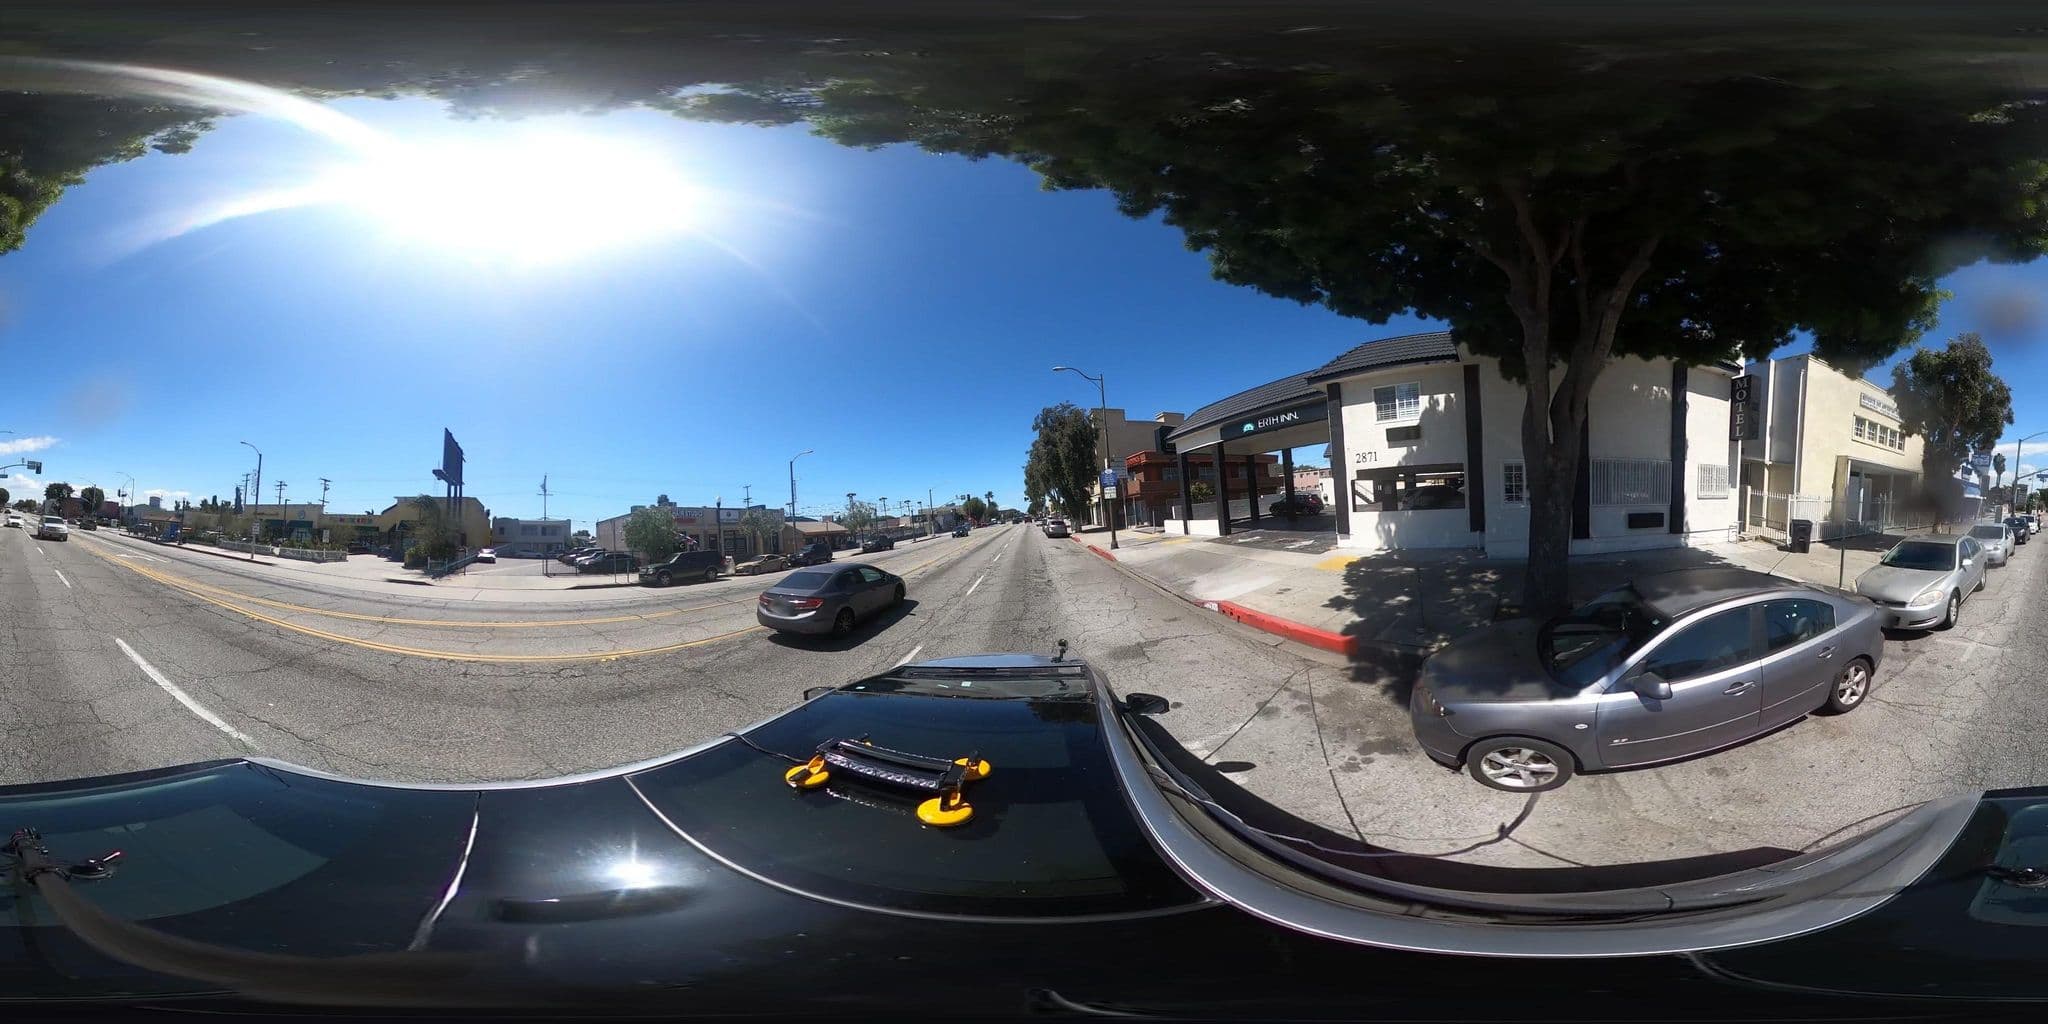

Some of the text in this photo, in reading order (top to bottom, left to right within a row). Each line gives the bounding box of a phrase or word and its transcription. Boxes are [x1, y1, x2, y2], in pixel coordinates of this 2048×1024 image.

[1735, 378, 1749, 437] MOTEL
[1257, 416, 1279, 428] ERTH
[1355, 451, 1378, 464] 2871
